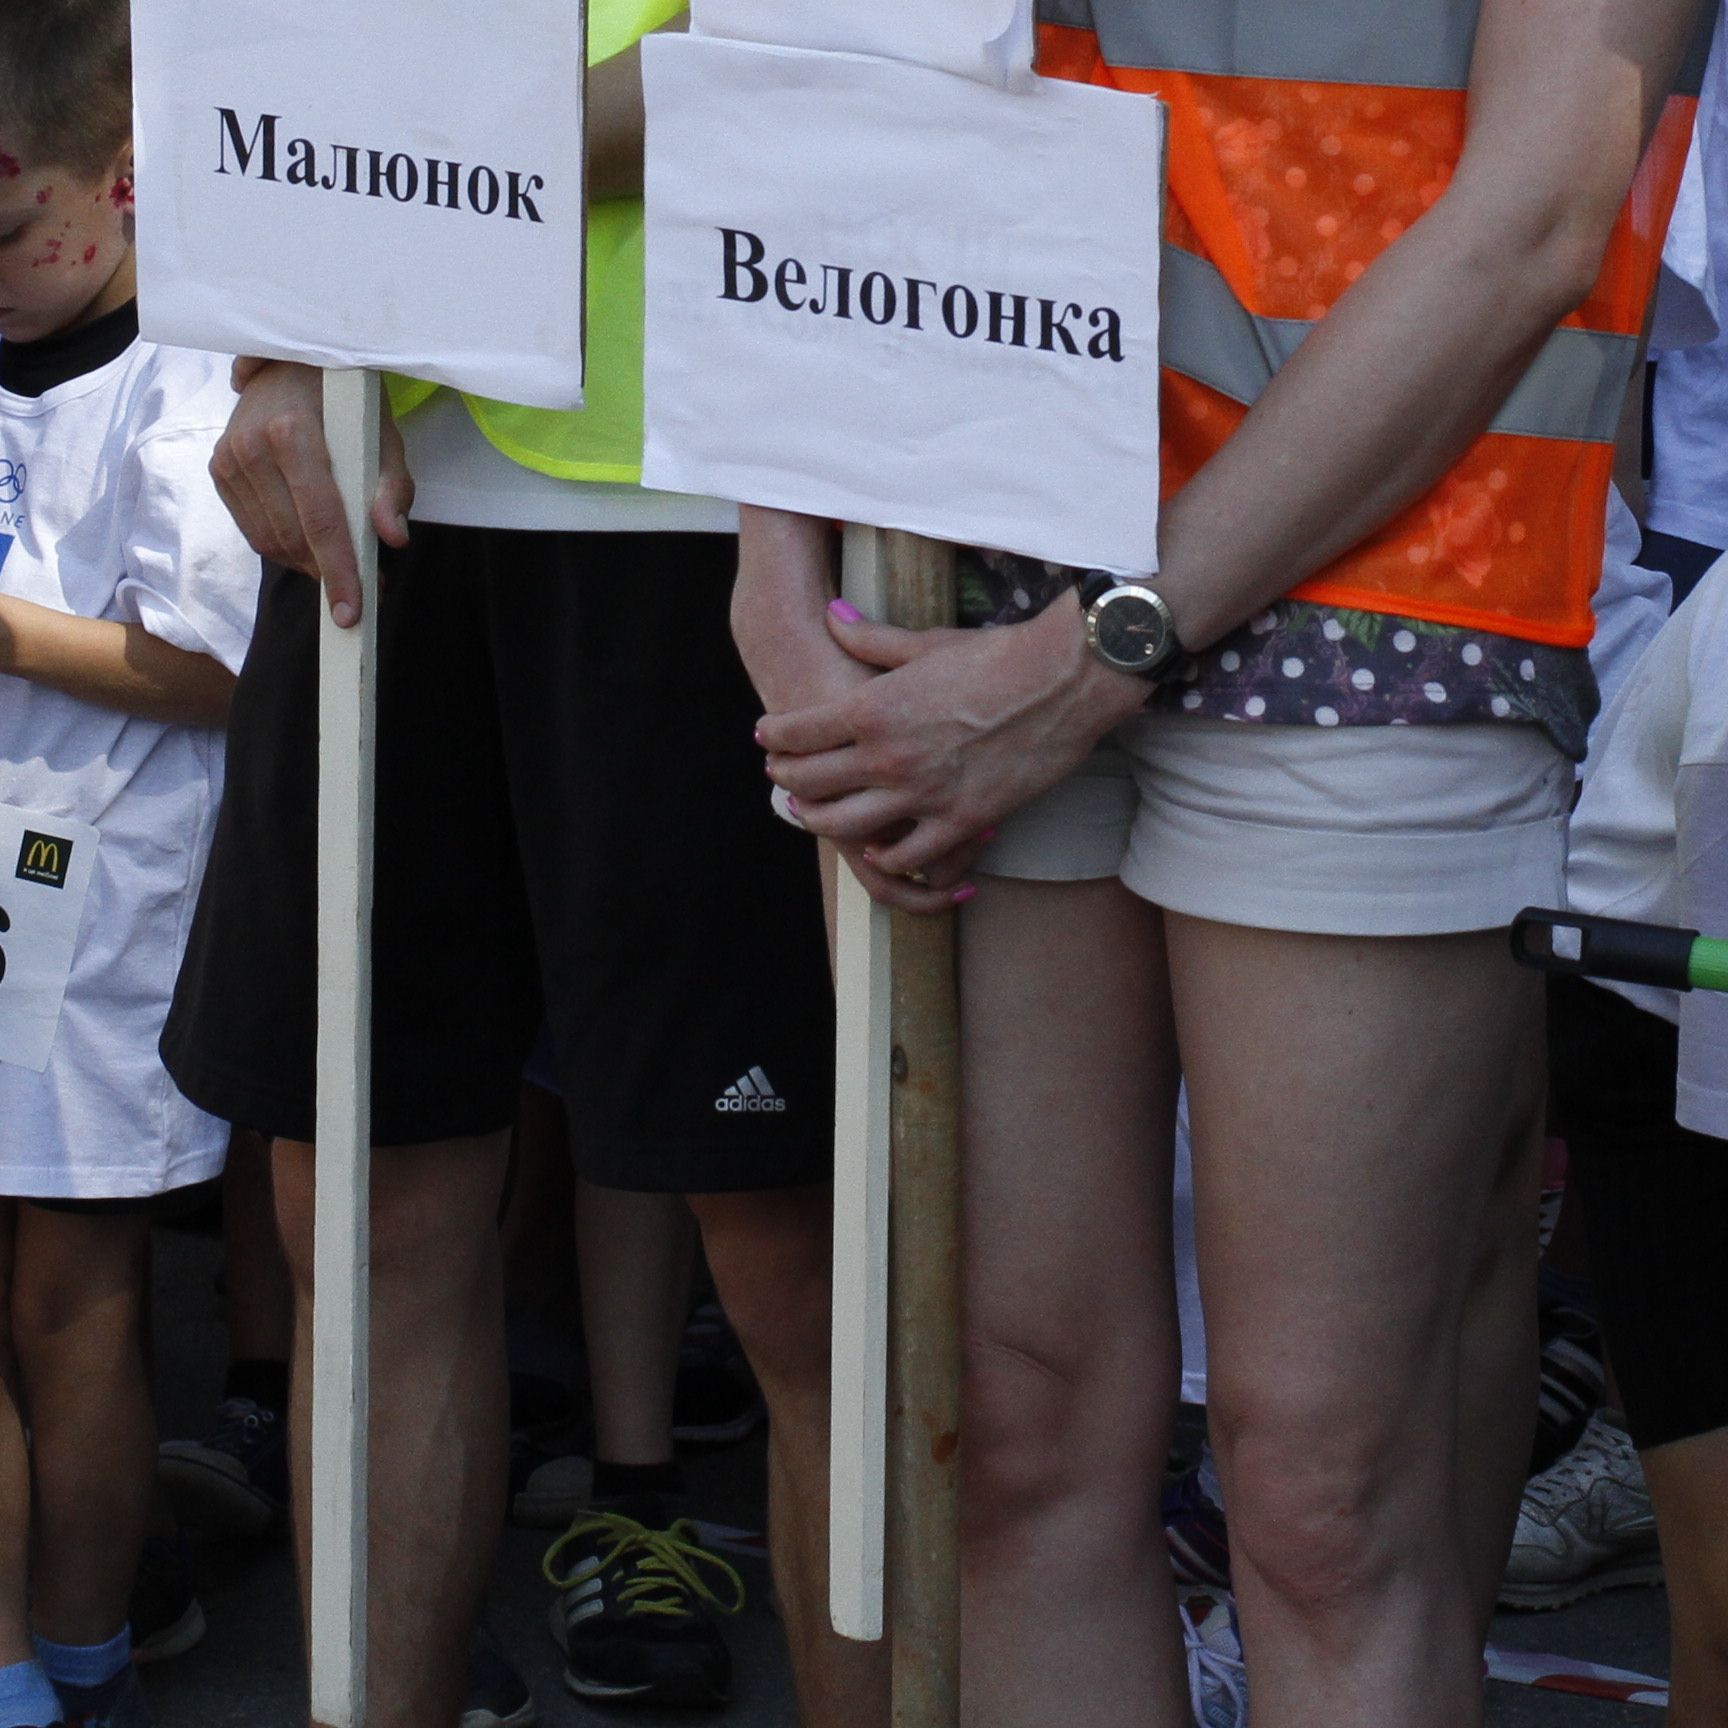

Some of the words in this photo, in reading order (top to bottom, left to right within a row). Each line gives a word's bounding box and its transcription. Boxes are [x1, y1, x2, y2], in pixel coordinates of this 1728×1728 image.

[213, 106, 545, 224] Малюнок
[714, 225, 1126, 364] Велогонка
[715, 1094, 786, 1112] adidas
